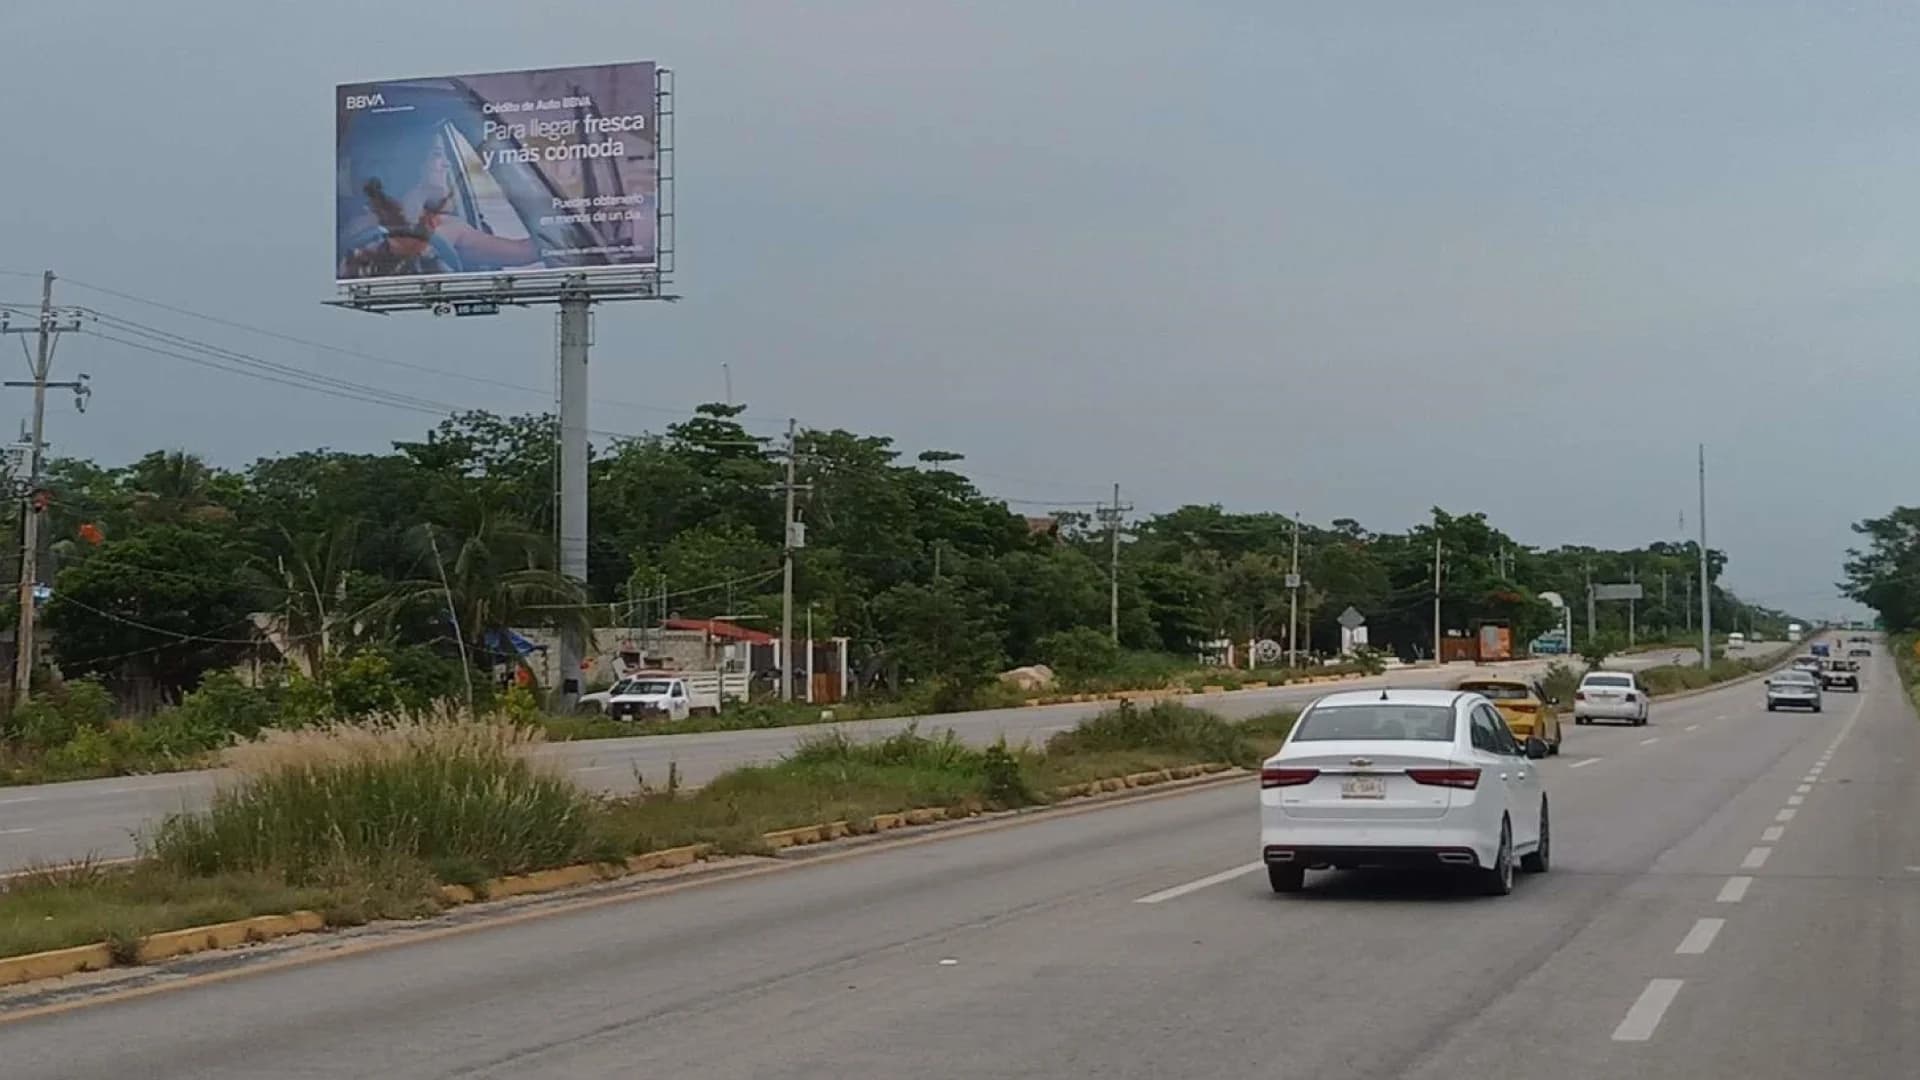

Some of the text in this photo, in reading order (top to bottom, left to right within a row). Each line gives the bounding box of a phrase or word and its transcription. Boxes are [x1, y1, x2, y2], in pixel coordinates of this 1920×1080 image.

[346, 93, 385, 109] BBVA
[483, 114, 645, 141] Para llegar fresca
[482, 138, 625, 170] y más cómoda
